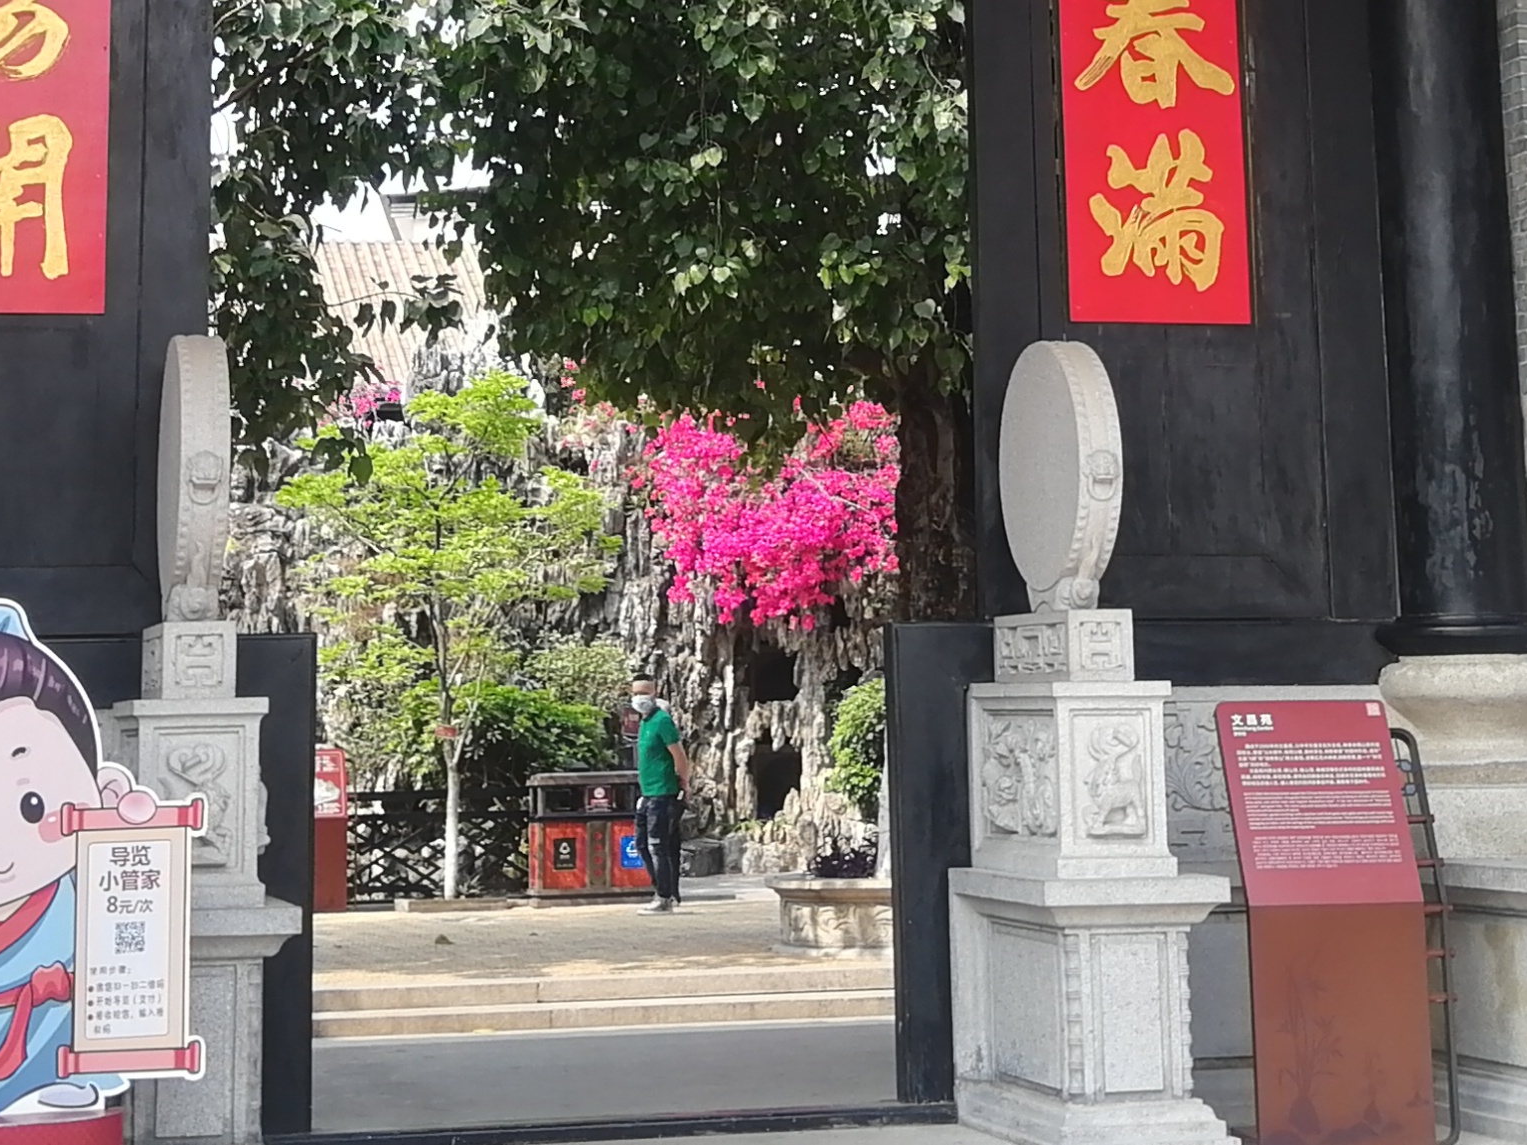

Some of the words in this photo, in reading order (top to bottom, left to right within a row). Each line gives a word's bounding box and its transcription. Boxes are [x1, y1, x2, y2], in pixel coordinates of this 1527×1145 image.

[109, 845, 152, 867] 导览
[99, 868, 162, 892] 小管家
[106, 896, 154, 915] 8元/次
